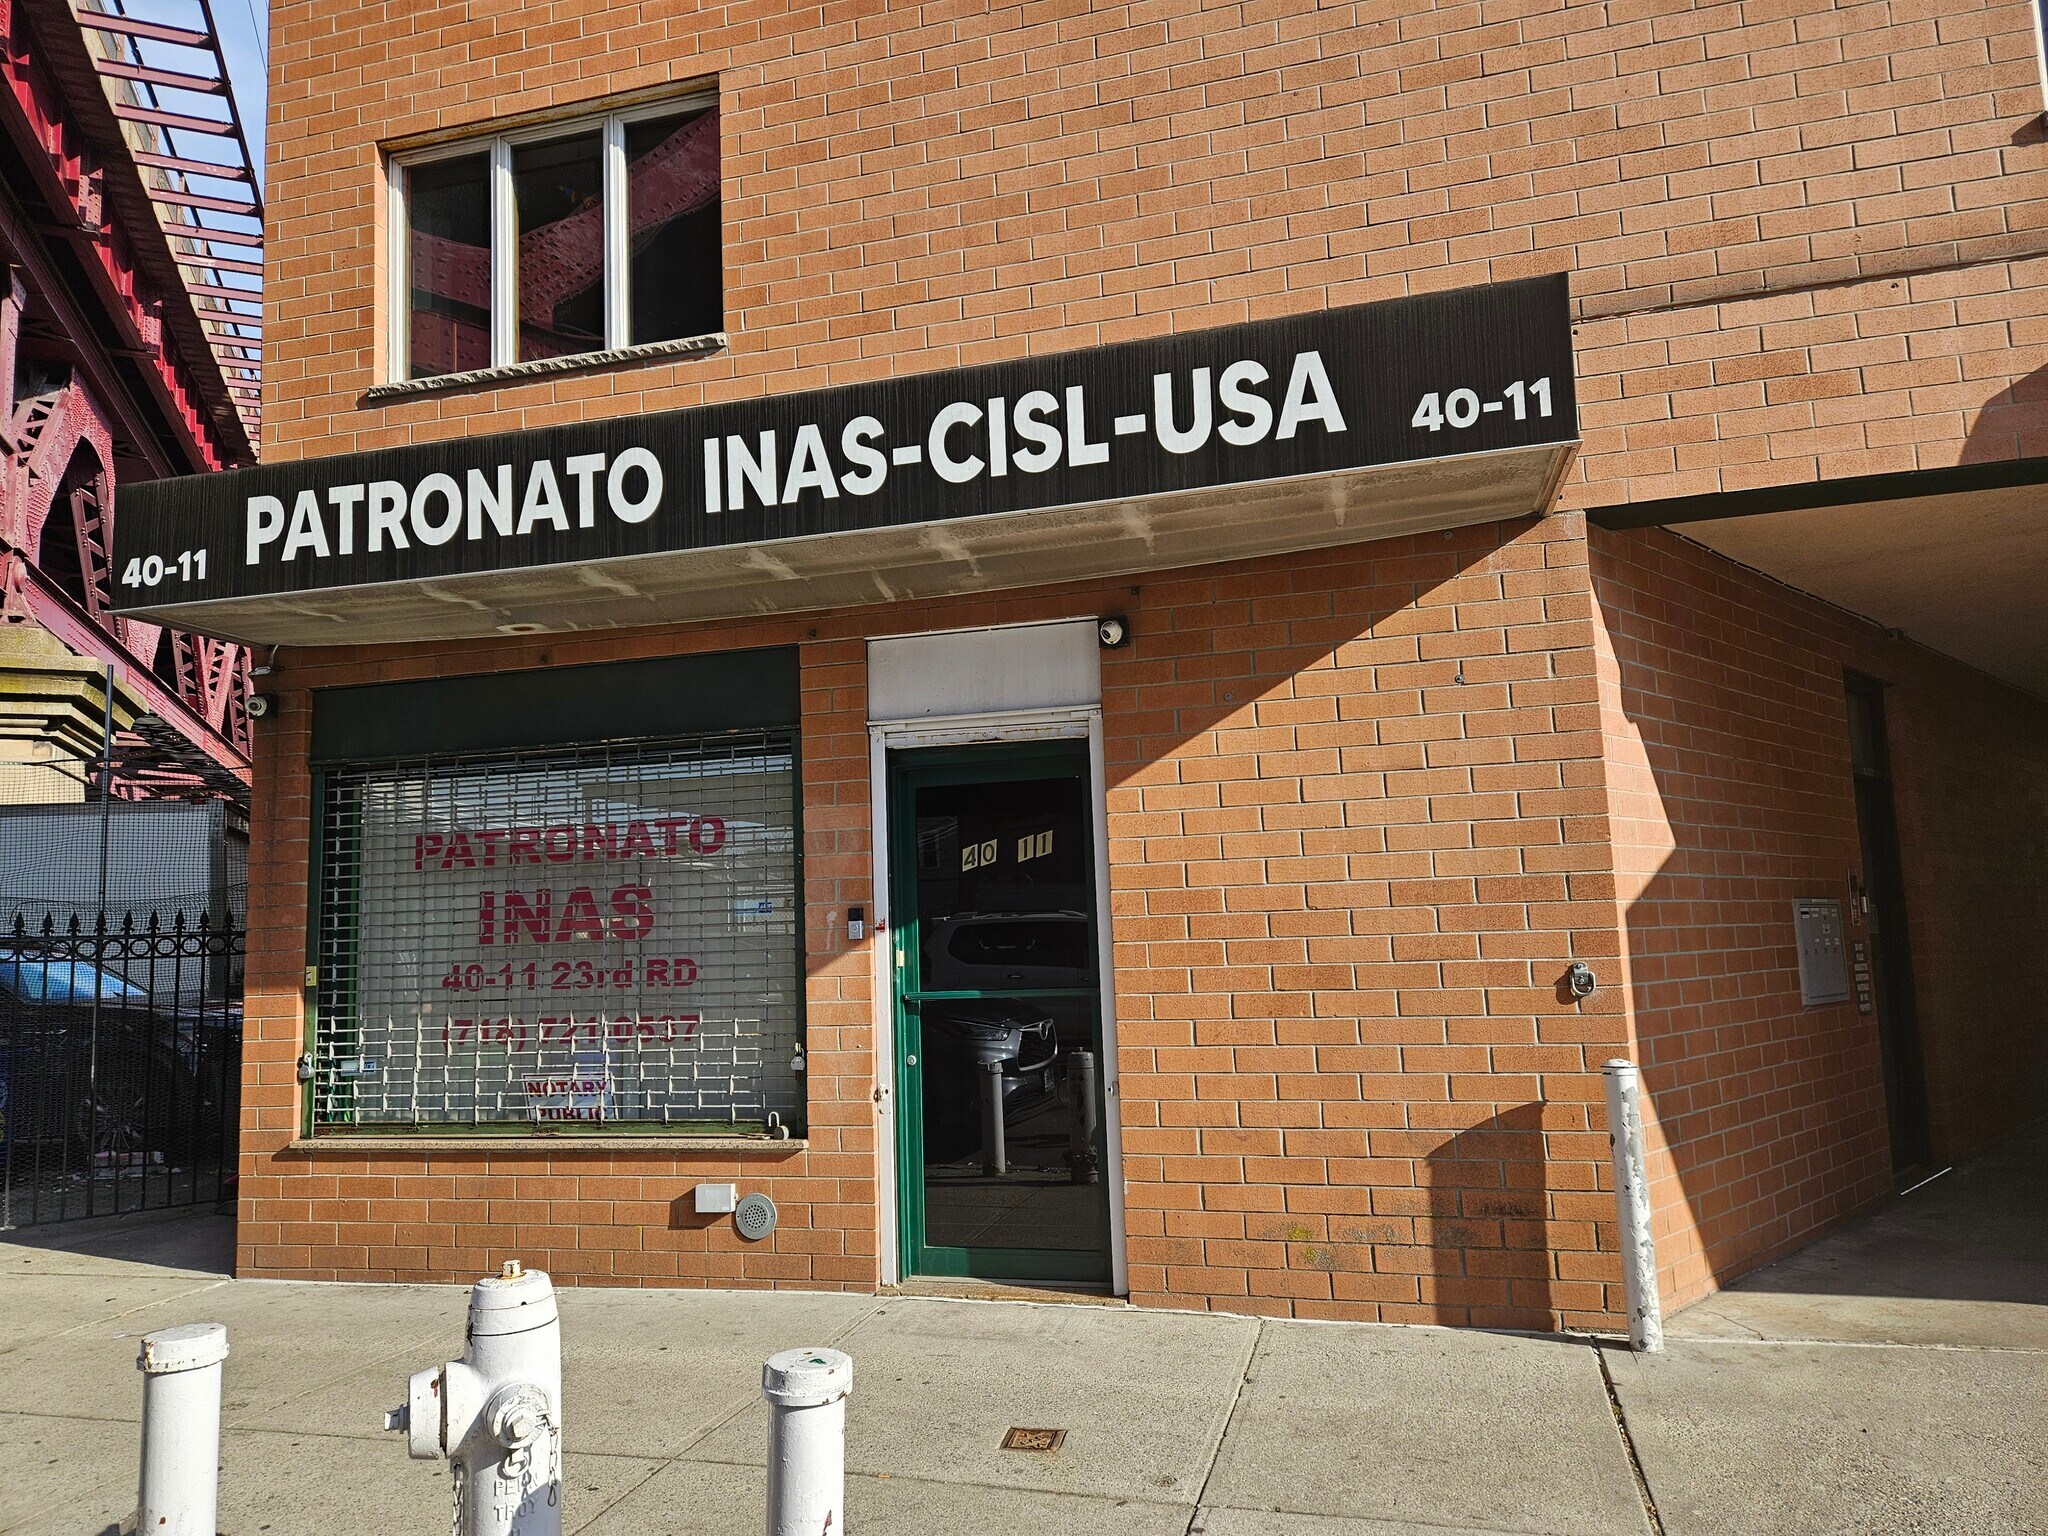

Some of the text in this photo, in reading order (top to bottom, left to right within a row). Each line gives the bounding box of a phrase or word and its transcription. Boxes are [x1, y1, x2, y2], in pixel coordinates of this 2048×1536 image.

[1411, 376, 1553, 432] 40-11
[246, 351, 1348, 566] PATRONATO INAS-CISL-USA
[122, 549, 207, 588] 40-11
[415, 817, 726, 870] PATRONATO
[963, 832, 1050, 868] 40 11
[479, 883, 655, 945] INAS
[442, 958, 697, 992] 40-11 23rd RD
[442, 1018, 526, 1053] (718)
[527, 1081, 608, 1097] NOTARY
